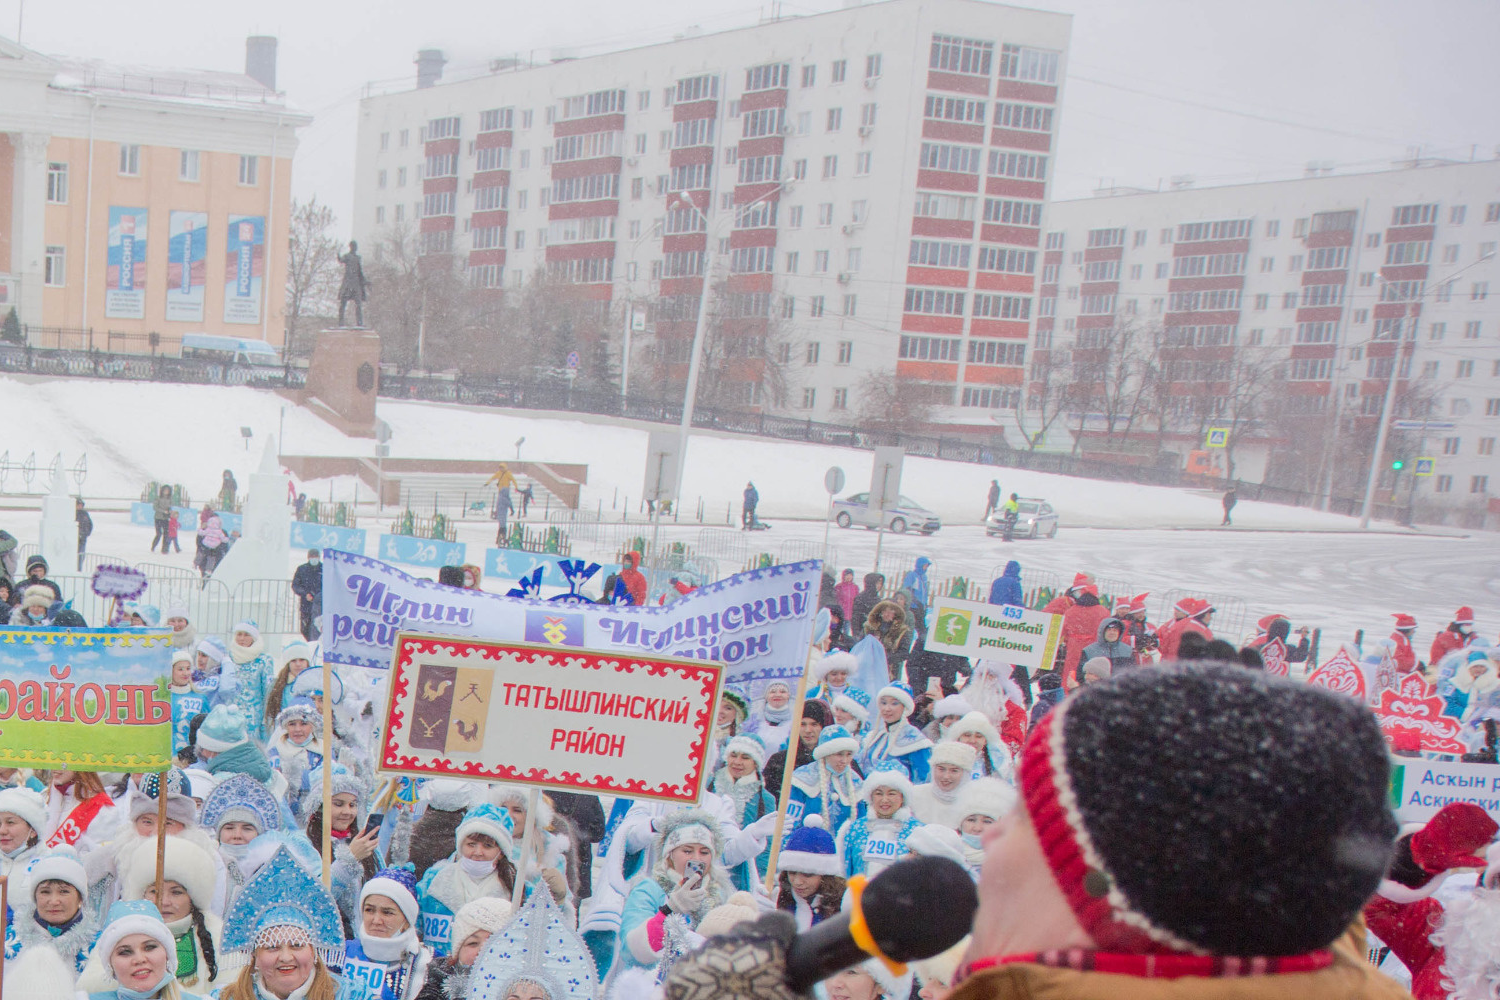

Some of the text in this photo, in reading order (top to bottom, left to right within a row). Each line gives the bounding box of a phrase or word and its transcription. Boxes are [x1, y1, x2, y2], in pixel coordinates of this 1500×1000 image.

[121, 238, 134, 287] РОССИЯ
[239, 244, 251, 293] РОССИЯ
[346, 574, 471, 624] Иглин
[1001, 606, 1023, 620] 453
[598, 580, 810, 650] Иглинский
[977, 614, 1044, 635] Ишембай
[978, 635, 1034, 653] районы
[502, 682, 691, 725] ТАТЫШЛИНСКИЙ
[550, 727, 626, 759] РАЙОН
[867, 840, 895, 856] 290
[424, 917, 449, 938] 282
[345, 962, 384, 989] 350
